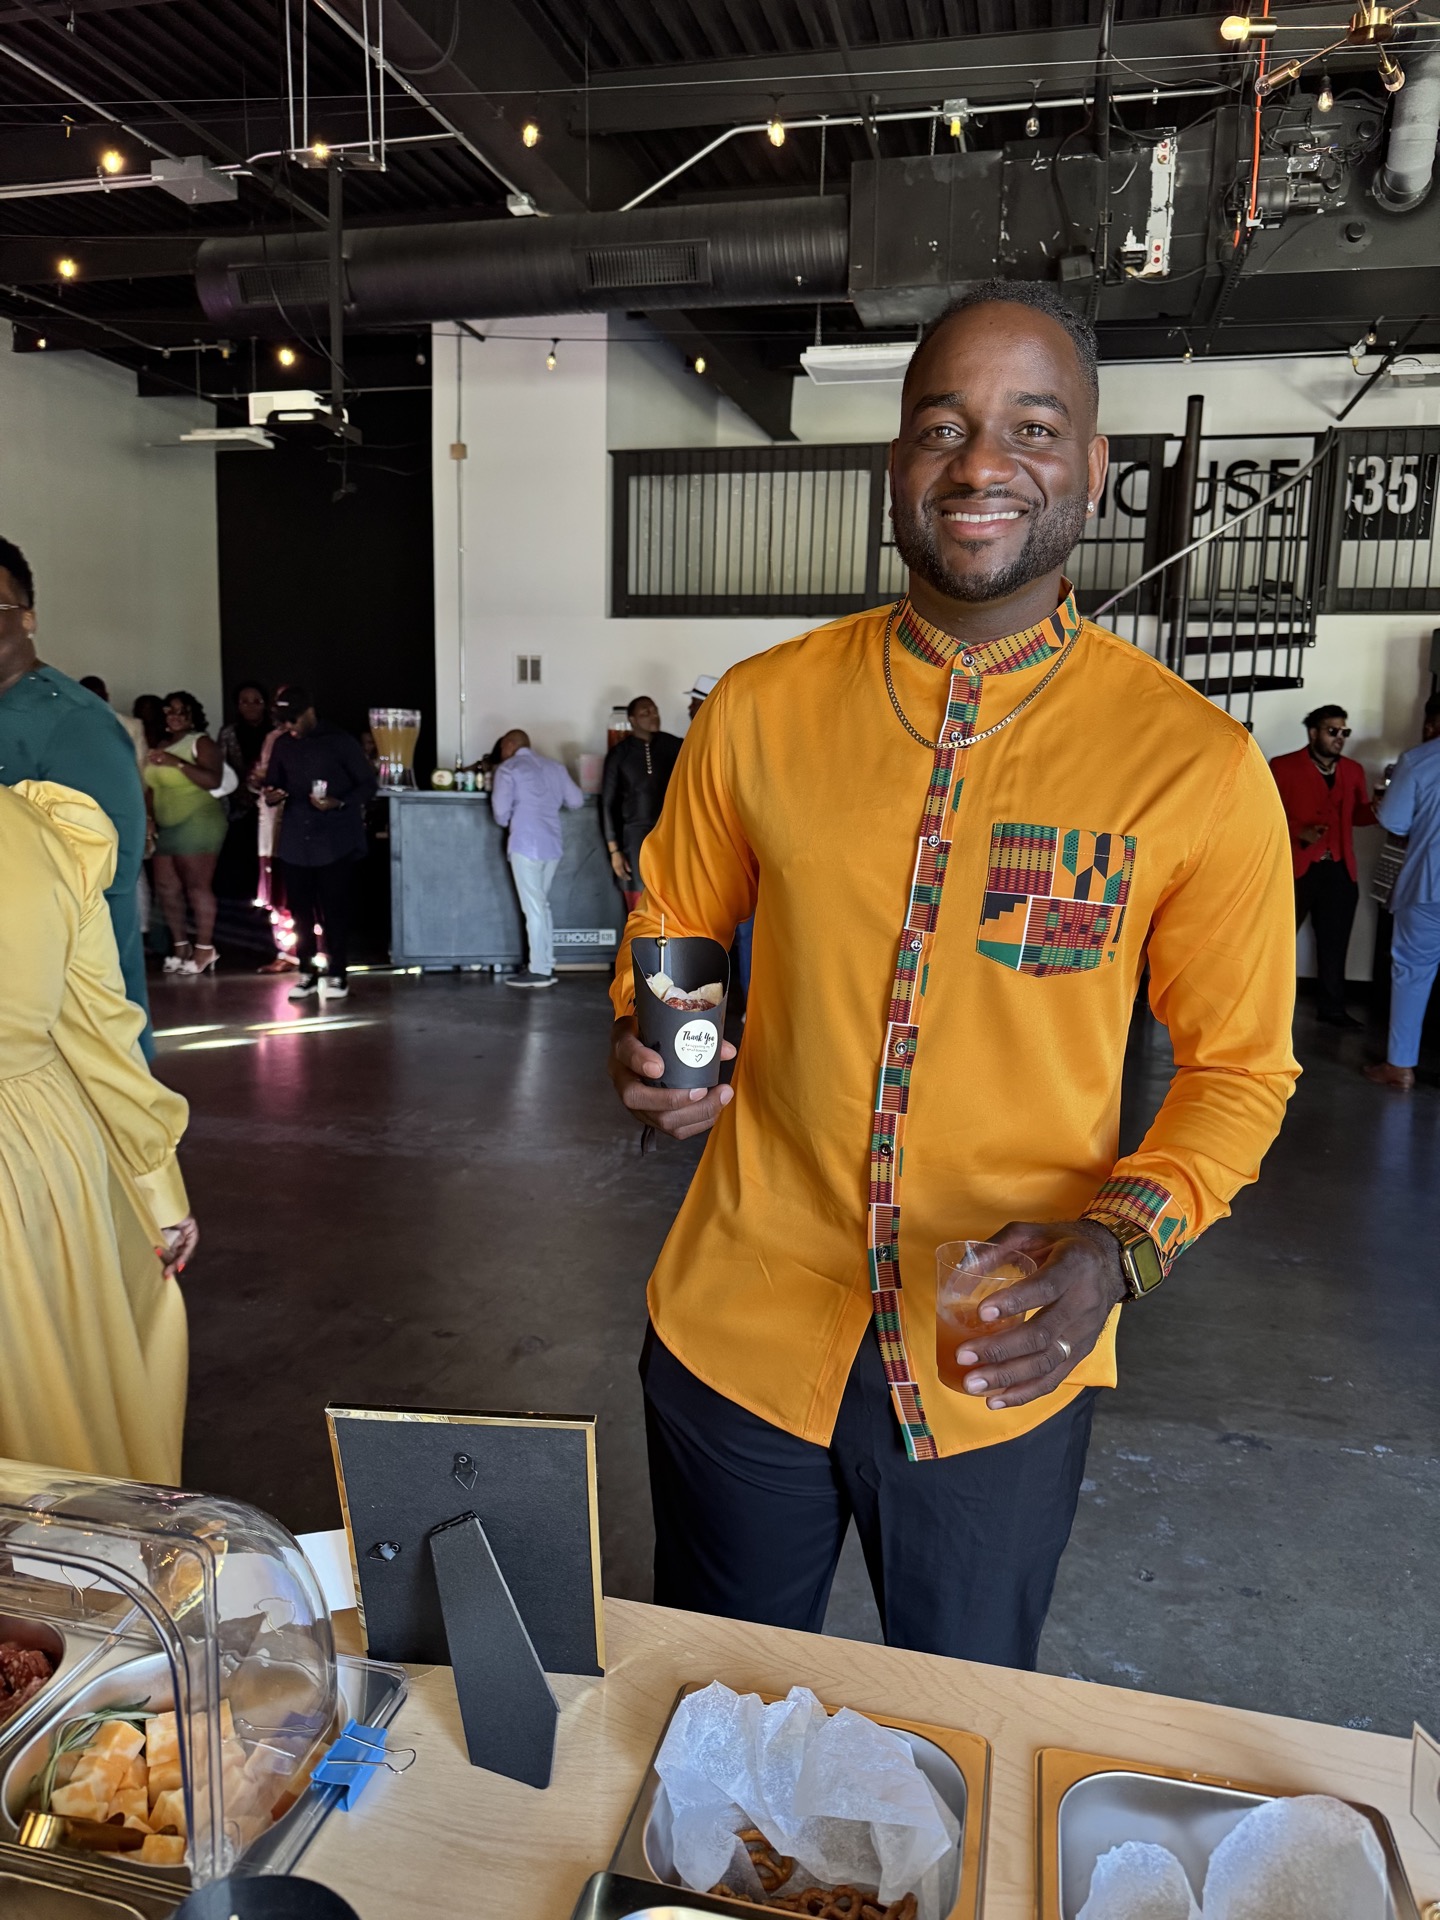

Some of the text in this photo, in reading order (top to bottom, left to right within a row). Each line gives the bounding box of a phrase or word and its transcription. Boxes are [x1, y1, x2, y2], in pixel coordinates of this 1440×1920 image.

[1099, 459, 1301, 519] OUSE
[683, 1031, 714, 1045] Thank You
